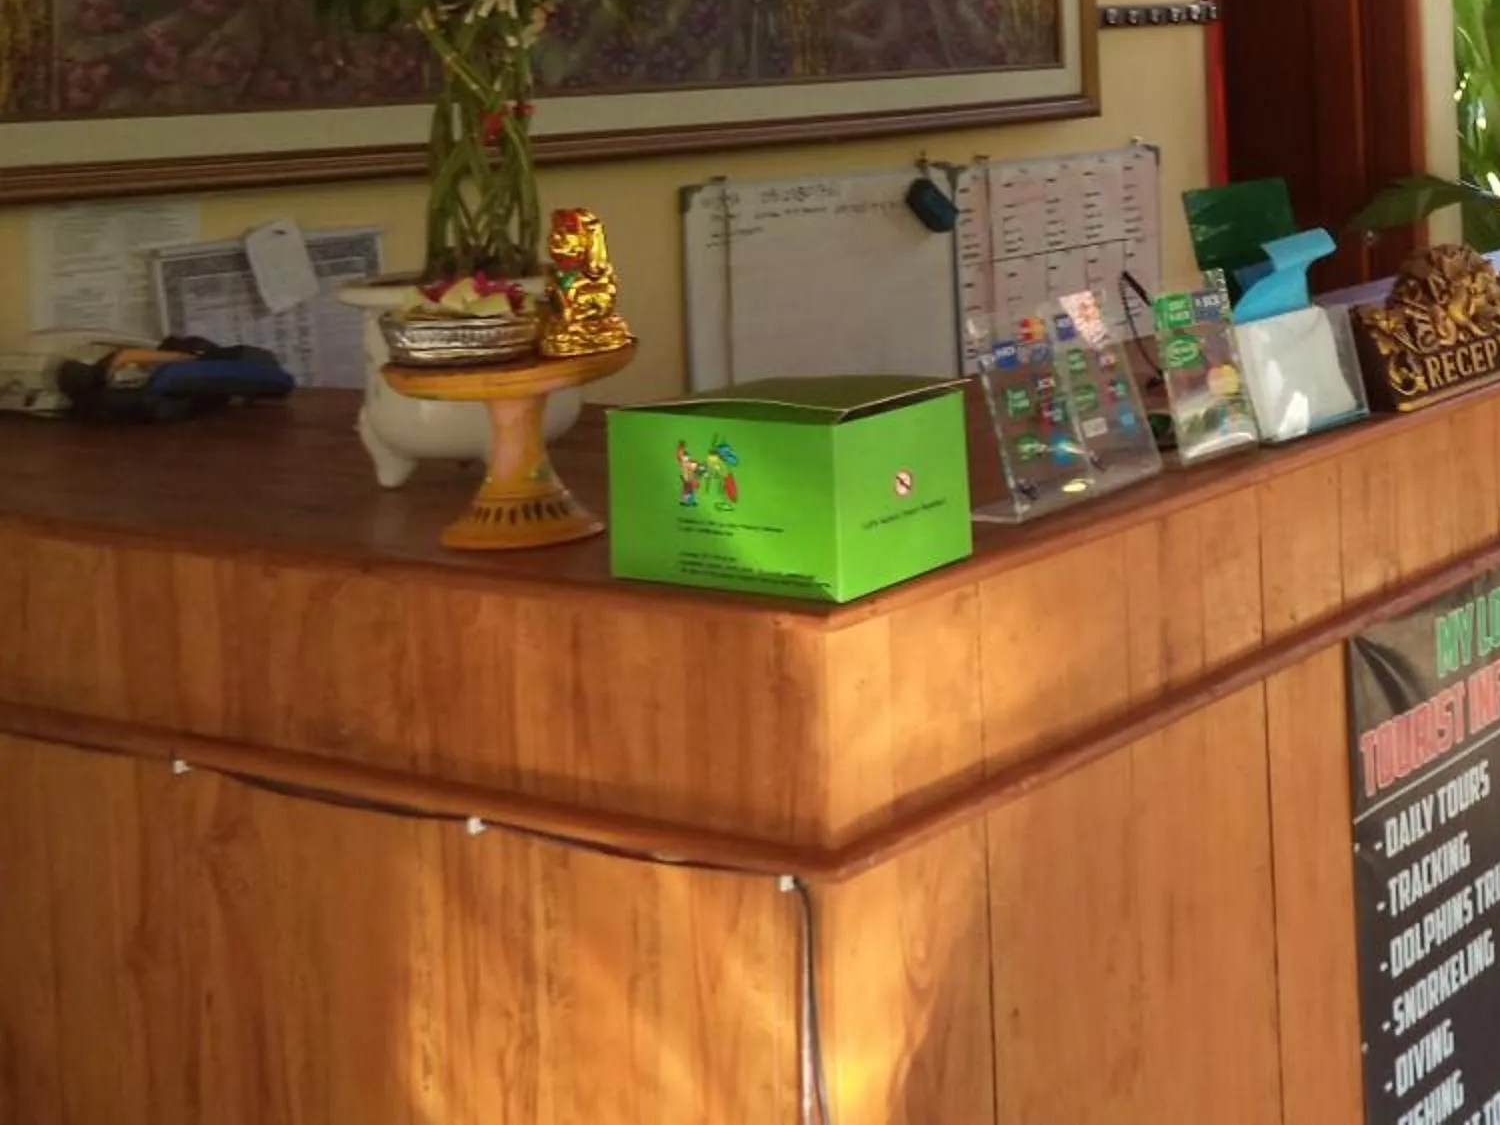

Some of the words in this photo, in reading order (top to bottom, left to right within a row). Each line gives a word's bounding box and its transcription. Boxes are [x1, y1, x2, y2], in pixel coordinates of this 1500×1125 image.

[1435, 601, 1475, 679] MY
[1360, 679, 1466, 799] TOURIST
[1384, 793, 1435, 859] DAILY
[1436, 759, 1491, 825] TOURS
[1387, 829, 1471, 918] TRACKING
[1389, 884, 1474, 980] DOLPHINS
[1392, 927, 1496, 1036] SNORKELING
[1394, 1018, 1455, 1098] DIVING
[1397, 1068, 1465, 1125] SHING
